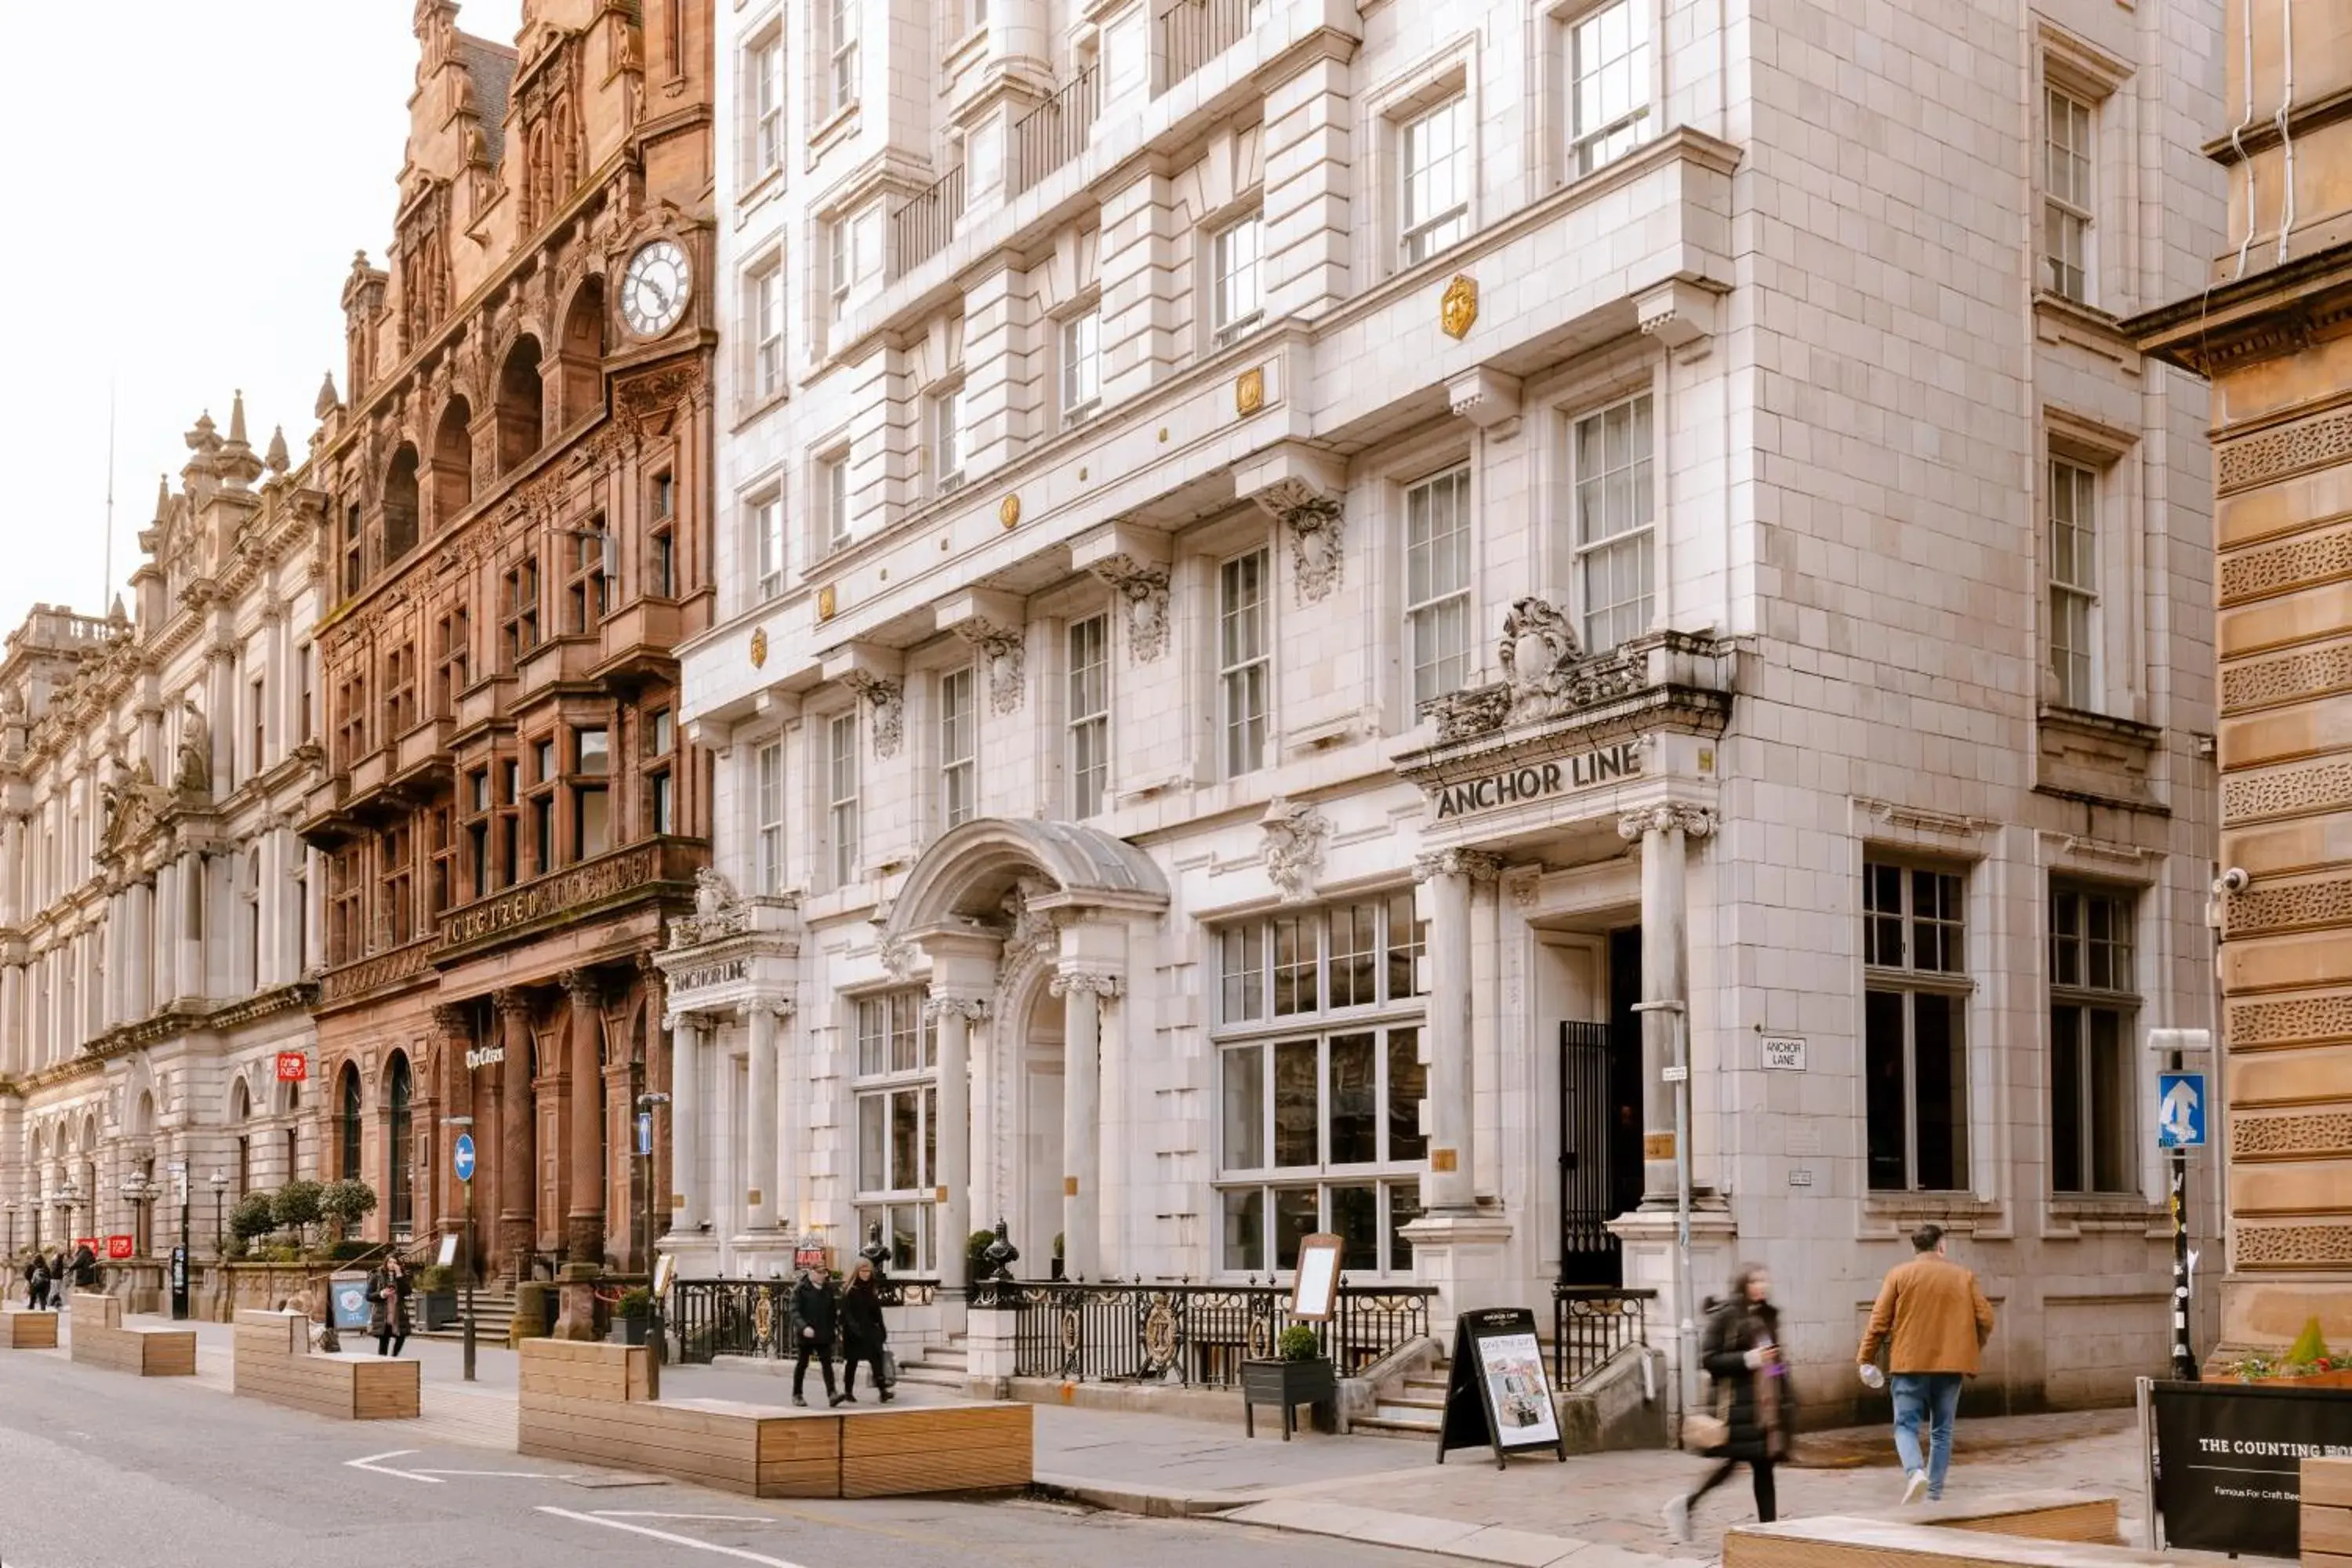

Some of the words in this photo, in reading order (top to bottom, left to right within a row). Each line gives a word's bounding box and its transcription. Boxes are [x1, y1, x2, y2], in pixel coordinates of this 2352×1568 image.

[1438, 764, 1561, 818] ANCHOR
[1572, 744, 1642, 786] LINE
[1766, 1041, 1801, 1053] ANCHOR
[1773, 1054, 1795, 1065] LANE
[2199, 1438, 2230, 1453] THE
[2234, 1439, 2321, 1457] COUNTING
[2214, 1486, 2245, 1497] Famous
[2246, 1489, 2258, 1498] For
[2262, 1490, 2282, 1501] Craft
